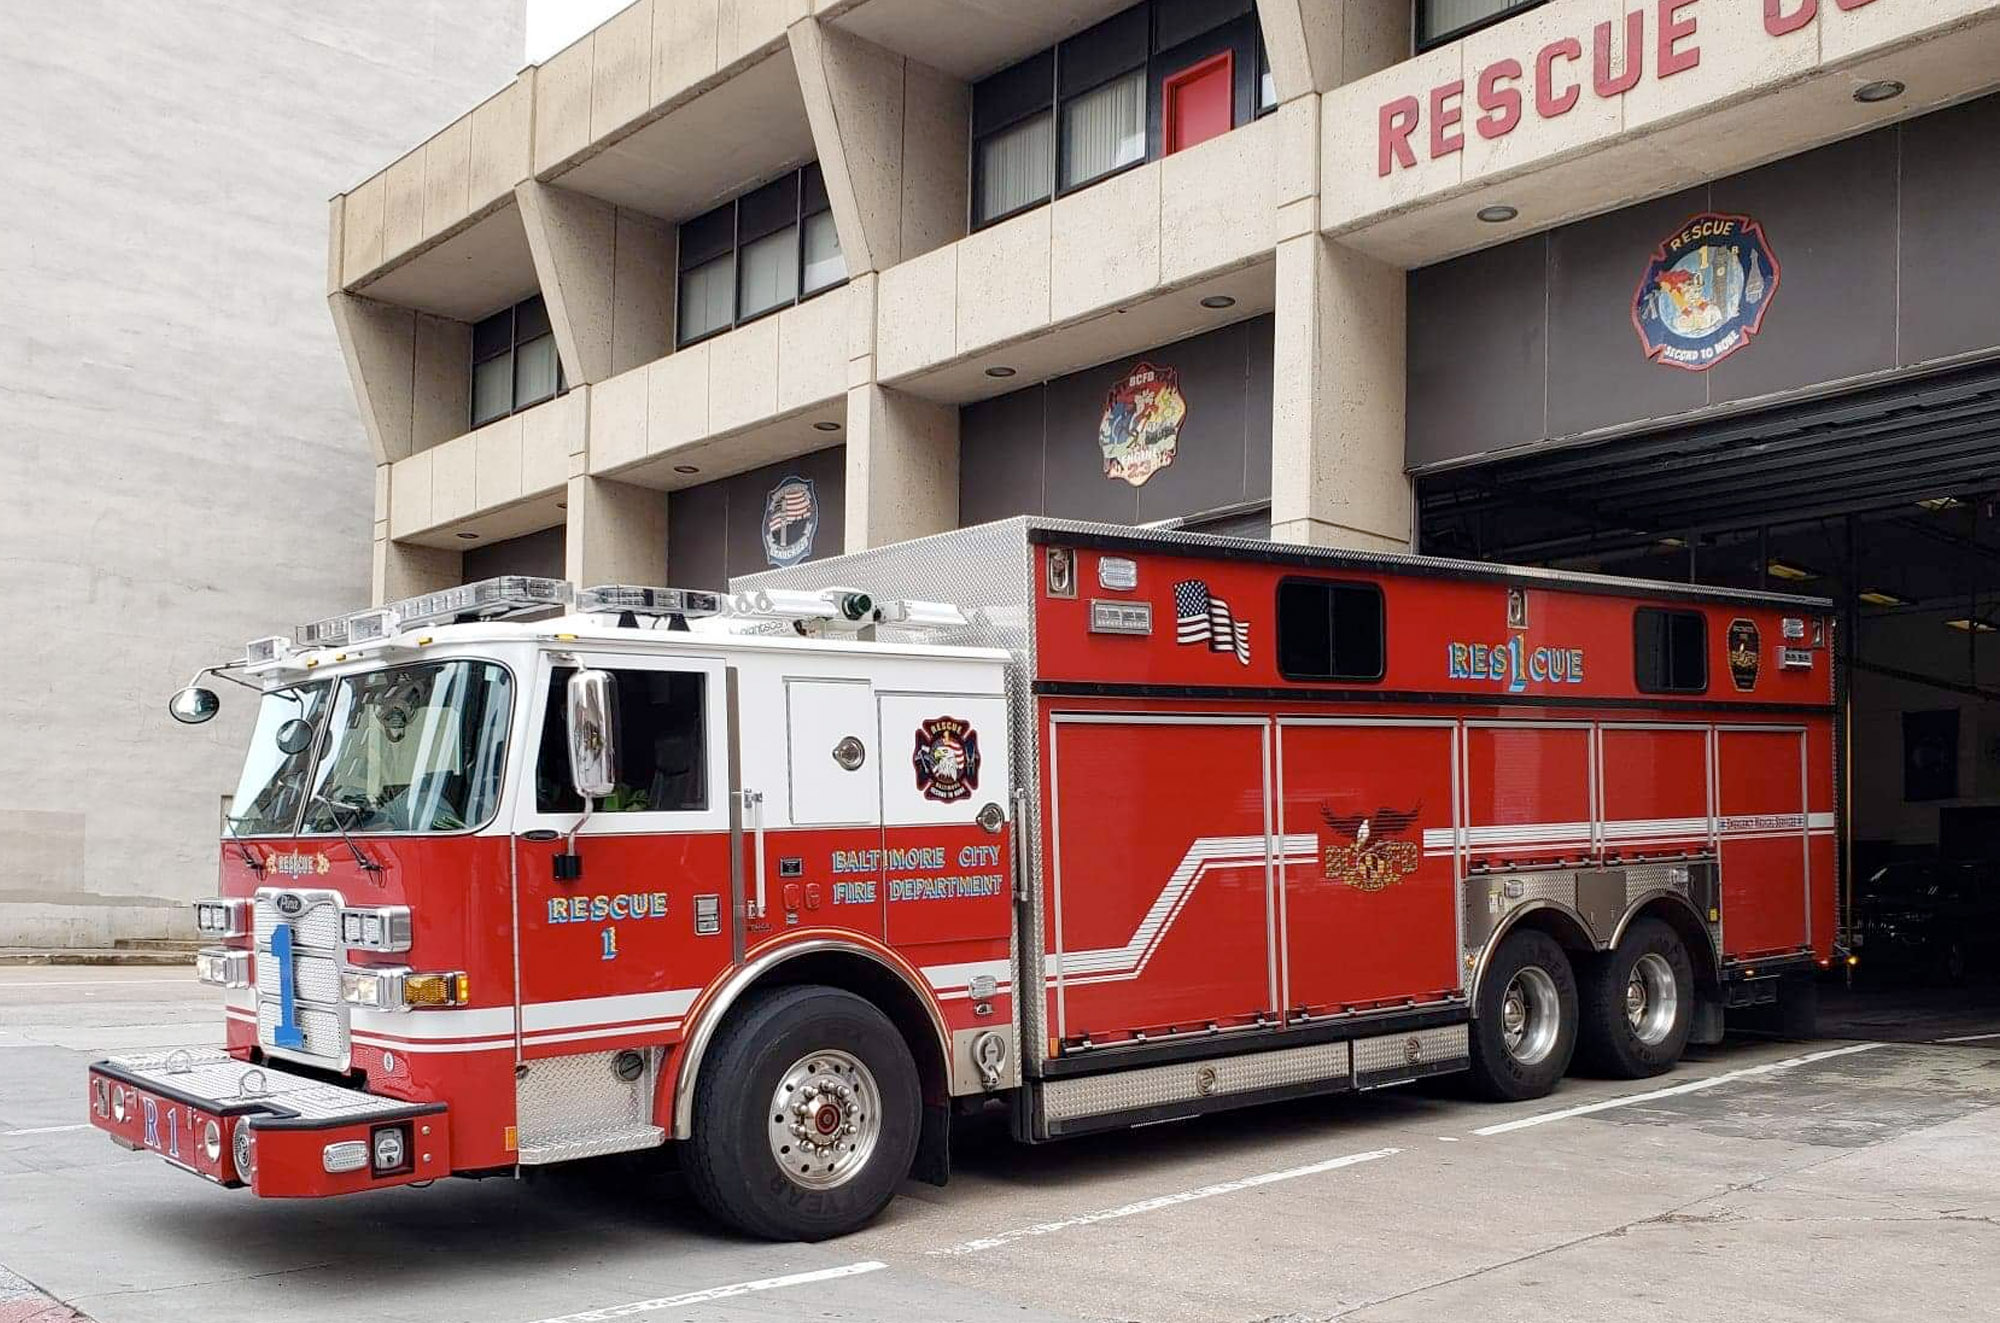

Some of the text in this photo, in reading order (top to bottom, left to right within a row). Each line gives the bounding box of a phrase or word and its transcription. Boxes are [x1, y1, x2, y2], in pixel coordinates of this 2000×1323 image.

[1378, 0, 1701, 178] RESCUE
[1670, 220, 1735, 251] RESCUE
[1701, 347, 1714, 359] TO
[930, 721, 963, 735] RESCUE
[832, 845, 1002, 874] BALTIMORE CITY
[832, 874, 1003, 905] FIRE DEPARTMENT
[548, 892, 668, 924] RESCUE
[601, 926, 619, 961] 1
[270, 924, 304, 1049] 1
